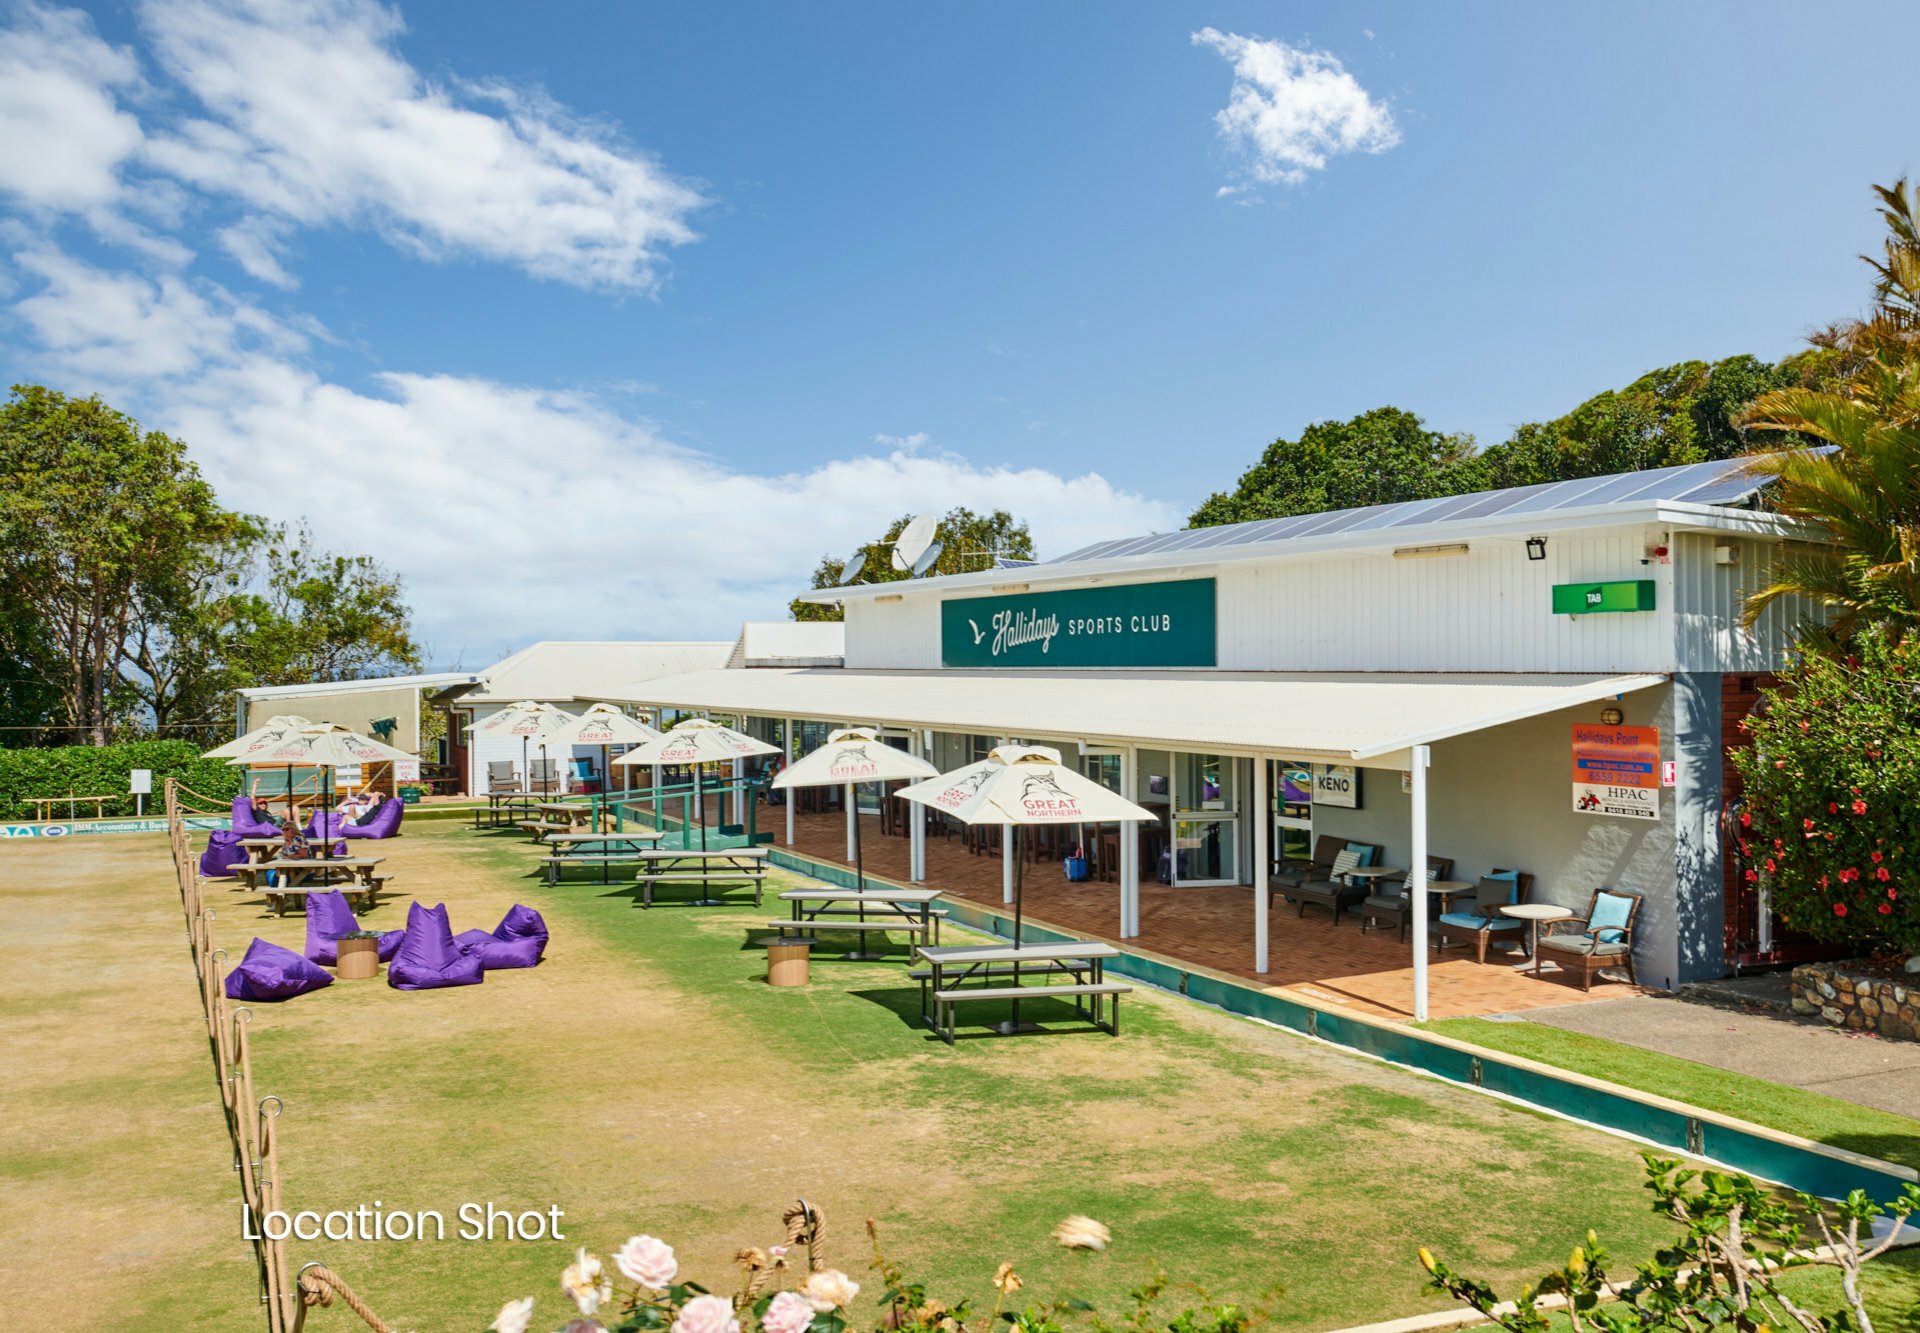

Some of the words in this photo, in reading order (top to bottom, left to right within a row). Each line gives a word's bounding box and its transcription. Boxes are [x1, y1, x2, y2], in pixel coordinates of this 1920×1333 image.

[1586, 593, 1602, 604] TAB
[992, 608, 1060, 656] Hallidays
[1068, 617, 1123, 636] SPORTS
[1130, 614, 1171, 633] CLUB
[578, 731, 614, 739] GREAT
[1577, 730, 1614, 748] Hallidays
[1616, 732, 1639, 746] Point
[661, 748, 697, 757] GREAT
[1577, 748, 1630, 760] Accommodation
[1318, 775, 1350, 792] KENO
[1589, 771, 1613, 782] 6559
[1617, 774, 1642, 785] 2222
[943, 787, 973, 801] GREAT
[1608, 787, 1649, 801] HPAC
[1023, 799, 1077, 809] GREAT
[1026, 809, 1082, 817] NORTHERN
[94, 821, 137, 831] Accountants
[140, 821, 148, 829] &
